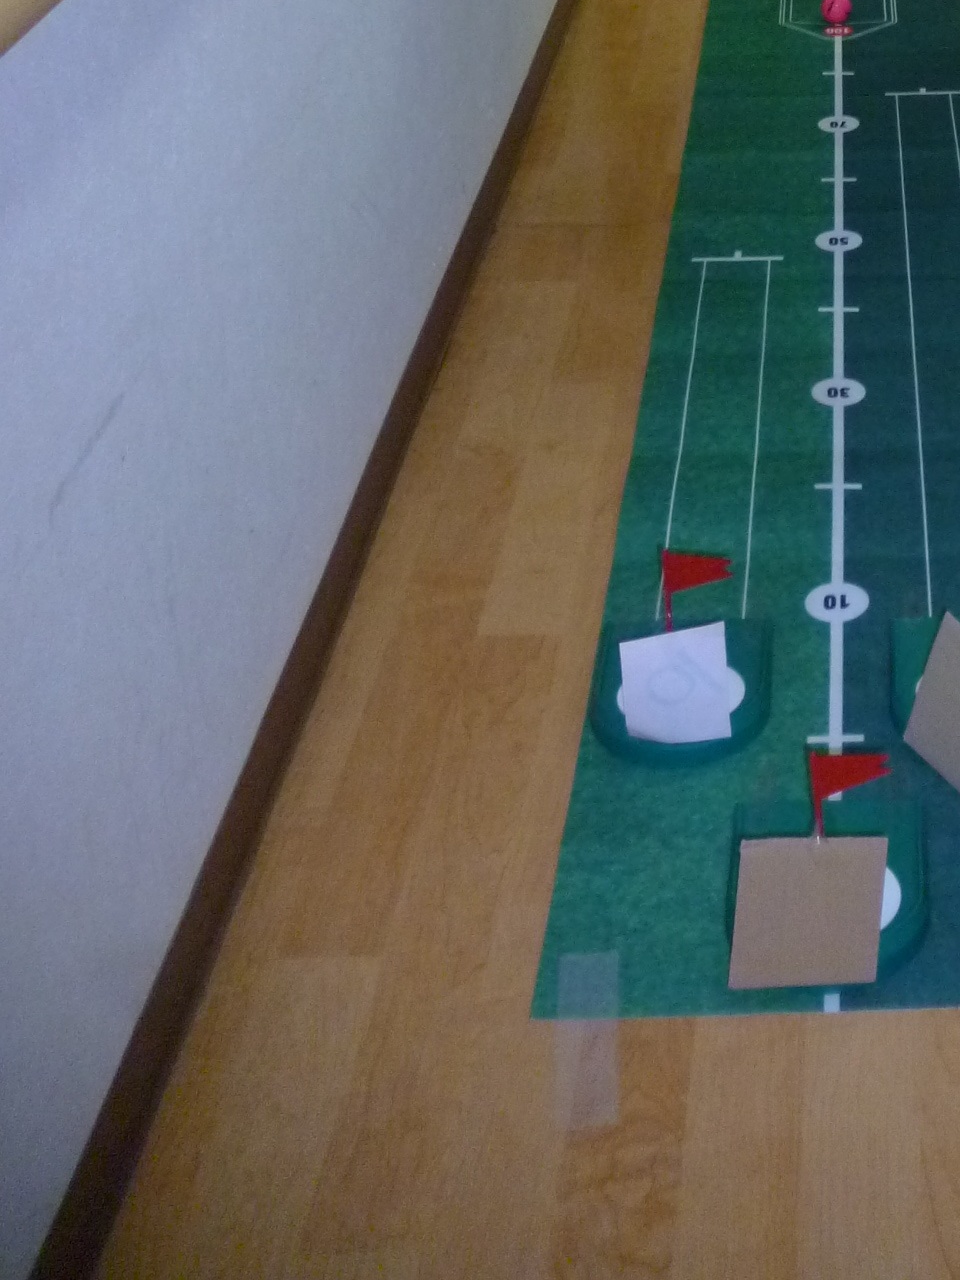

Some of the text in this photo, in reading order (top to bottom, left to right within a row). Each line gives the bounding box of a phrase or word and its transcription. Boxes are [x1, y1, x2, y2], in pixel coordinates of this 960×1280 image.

[829, 121, 848, 129] 70
[828, 237, 849, 246] 50
[827, 387, 850, 399] 30
[823, 594, 850, 611] 10
